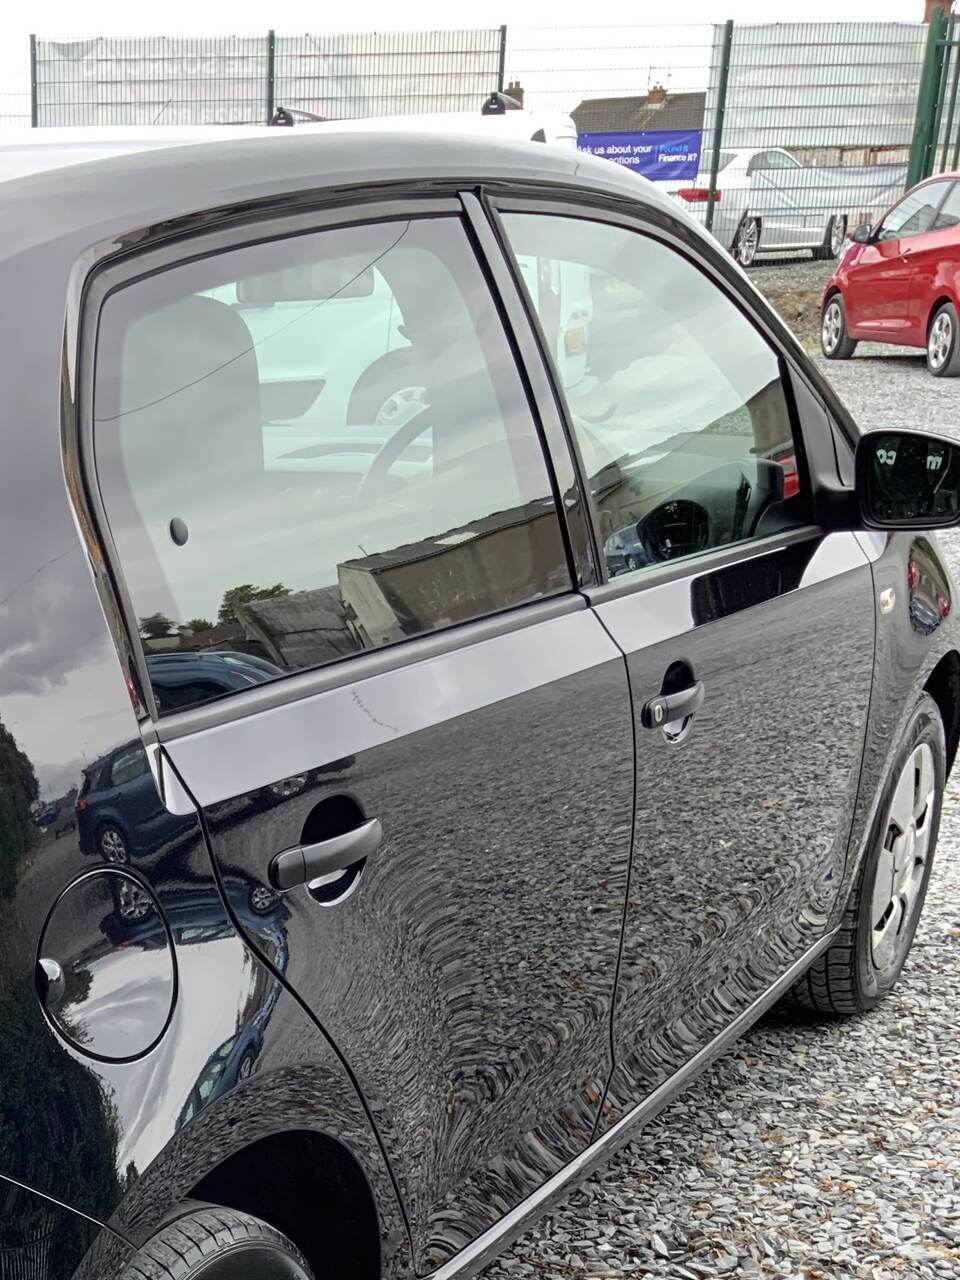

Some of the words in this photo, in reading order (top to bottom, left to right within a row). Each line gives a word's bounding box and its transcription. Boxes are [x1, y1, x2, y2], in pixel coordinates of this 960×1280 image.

[594, 147, 604, 155] us
[606, 145, 631, 154] about
[633, 145, 652, 155] your
[658, 154, 686, 162] Finance
[687, 153, 698, 161] it?
